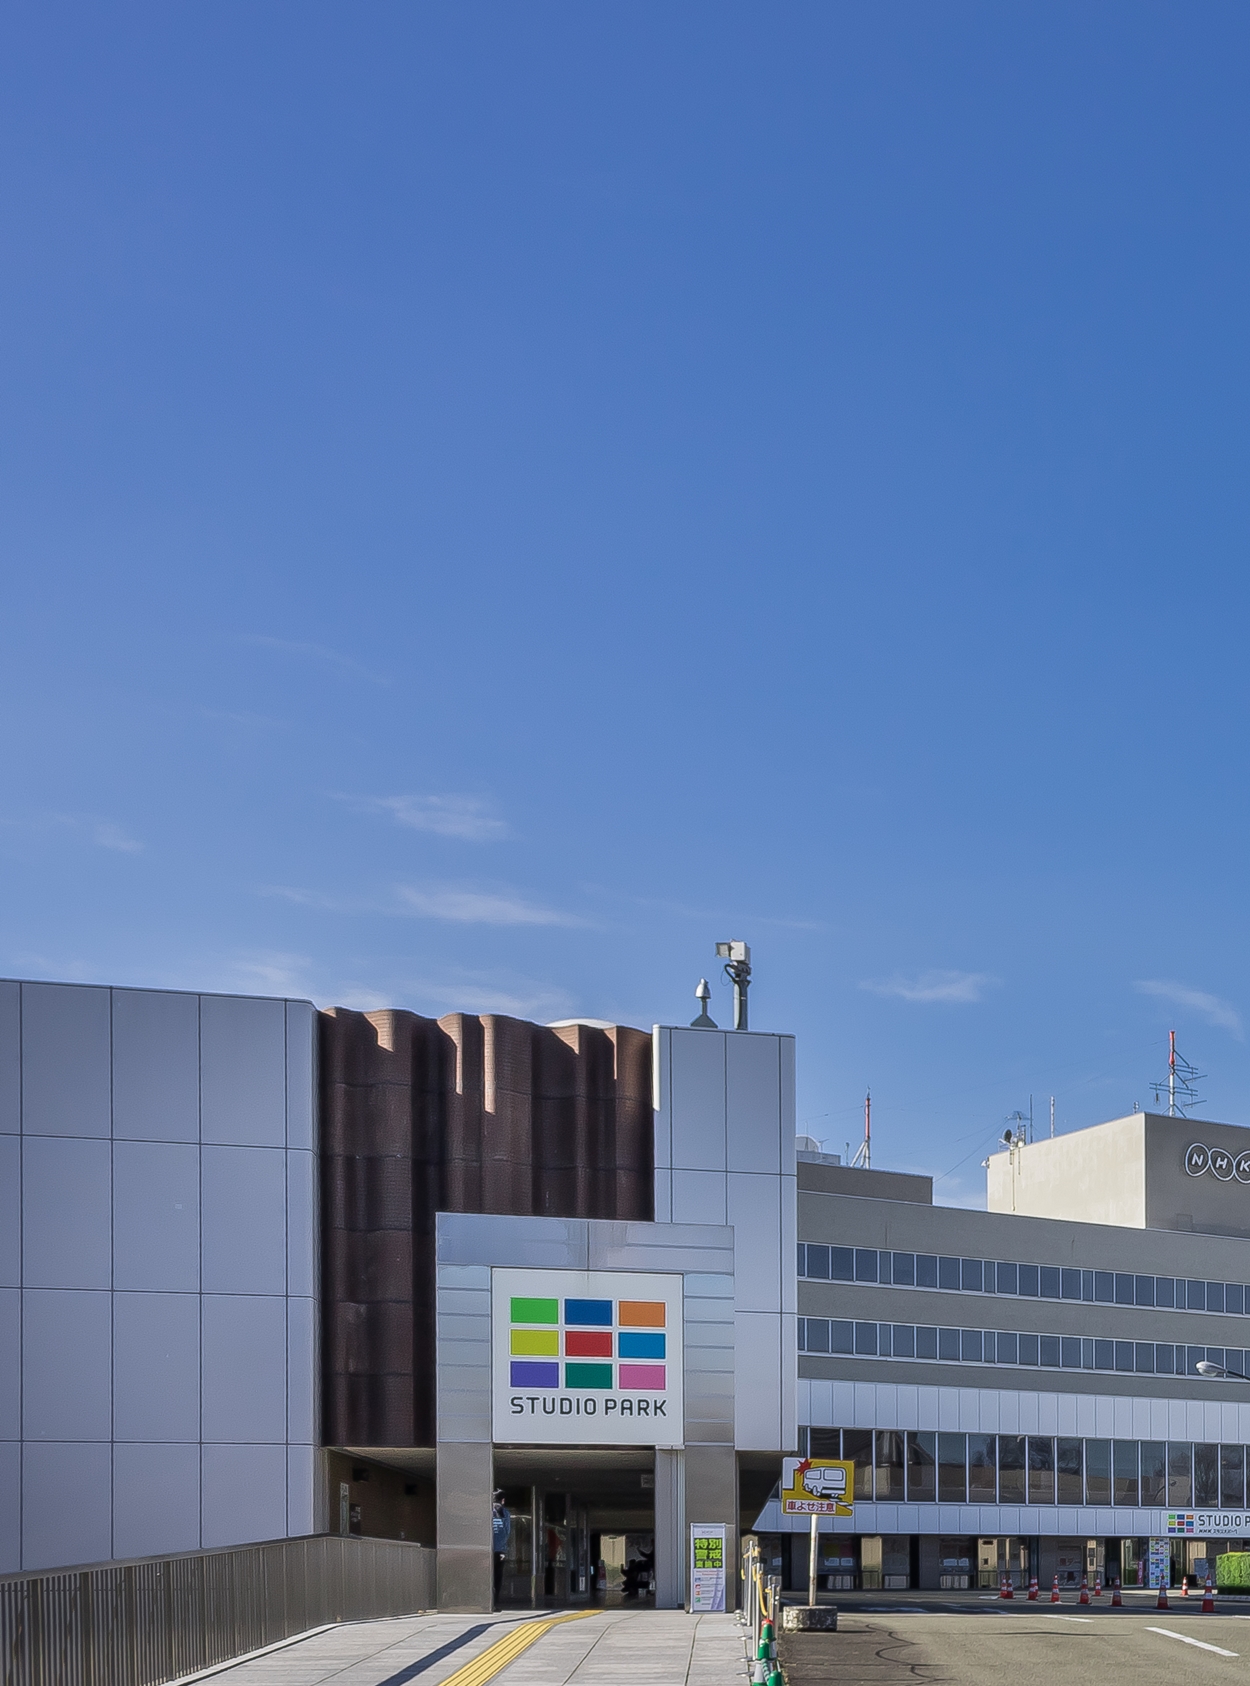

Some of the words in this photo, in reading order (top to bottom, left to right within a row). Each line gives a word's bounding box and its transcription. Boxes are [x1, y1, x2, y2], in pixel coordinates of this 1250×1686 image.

[510, 1396, 598, 1416] STUDIO
[604, 1398, 668, 1417] PARK
[787, 1500, 835, 1513] 車よせ注意
[1198, 1514, 1242, 1527] STUDIO
[695, 1538, 722, 1549] 特別
